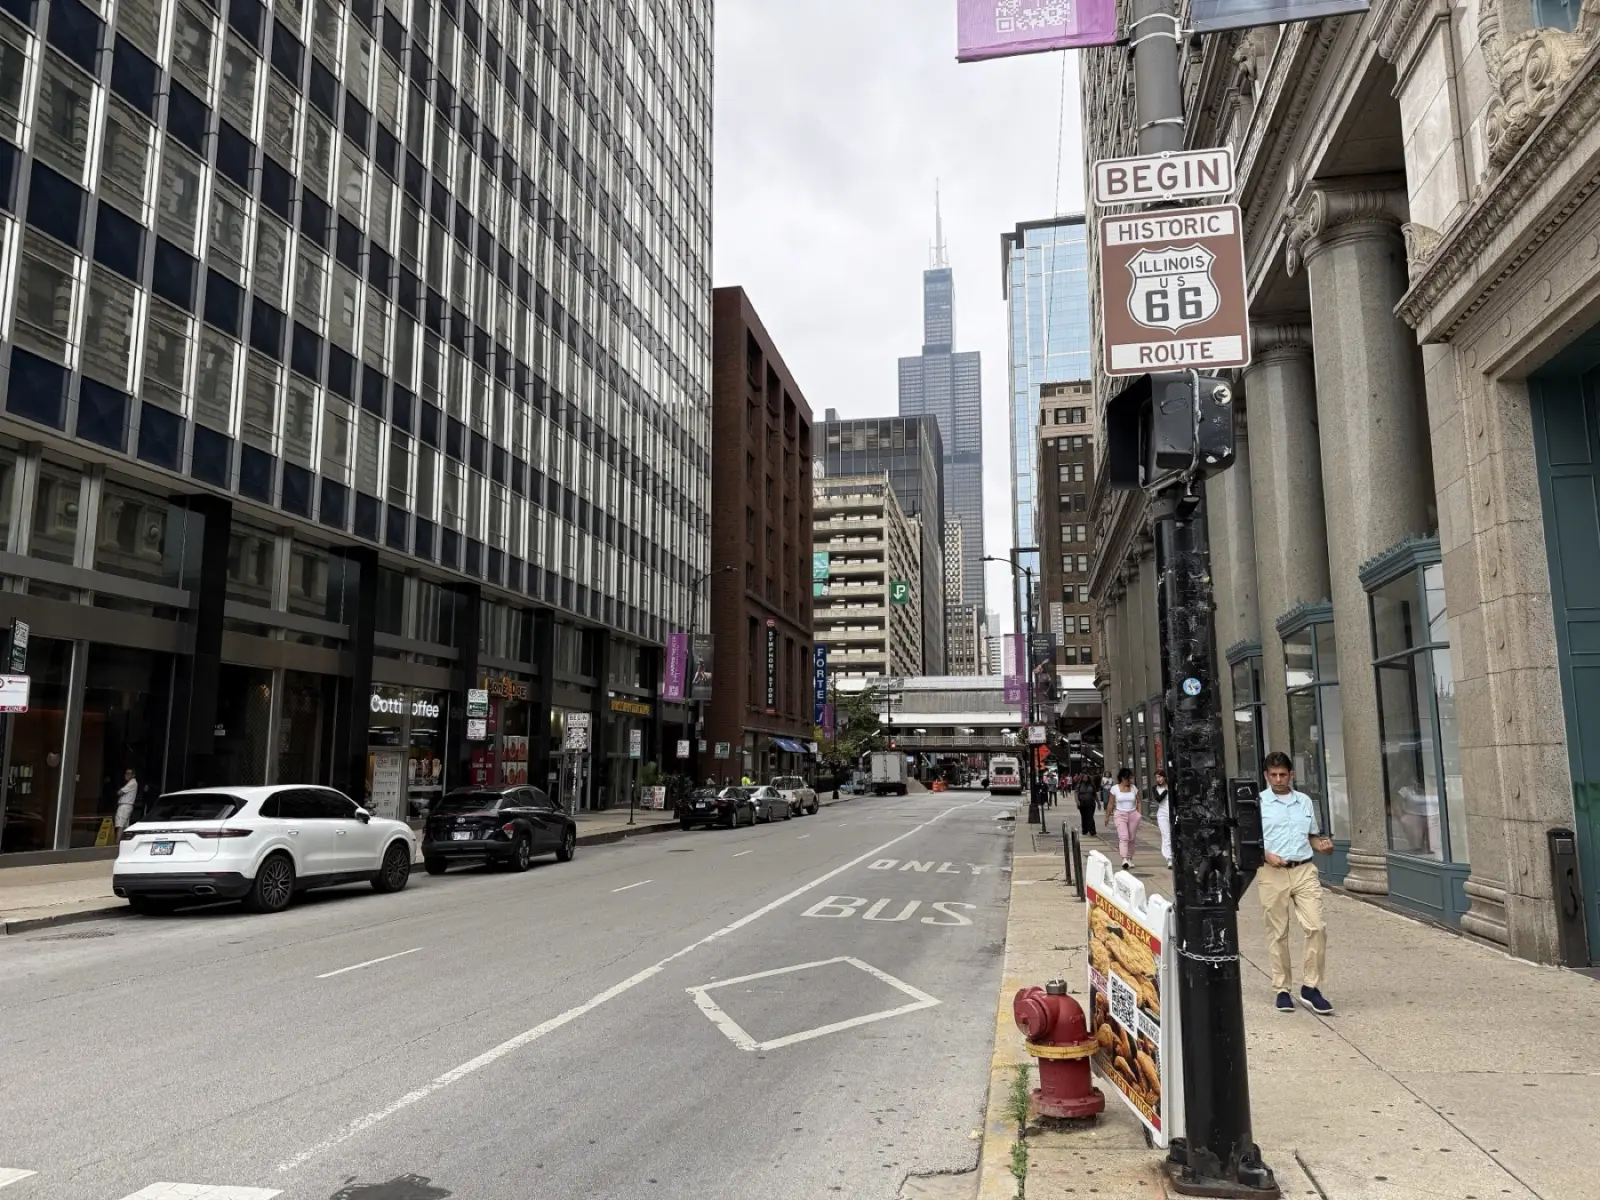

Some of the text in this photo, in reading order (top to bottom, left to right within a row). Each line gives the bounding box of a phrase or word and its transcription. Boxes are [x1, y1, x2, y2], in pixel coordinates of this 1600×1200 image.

[1107, 158, 1220, 195] BEGIN
[1118, 215, 1221, 242] HISTORIC
[1138, 255, 1206, 273] ILLINOIS
[1144, 286, 1203, 323] 66
[1139, 341, 1214, 364] ROUTE
[816, 648, 825, 699] FORTE
[371, 694, 440, 718] Cotti offee
[867, 858, 988, 875] ONLY
[800, 895, 977, 926] BUS
[1095, 894, 1152, 947] CATFISH STEAK
[1129, 1088, 1153, 1122] WINGS
